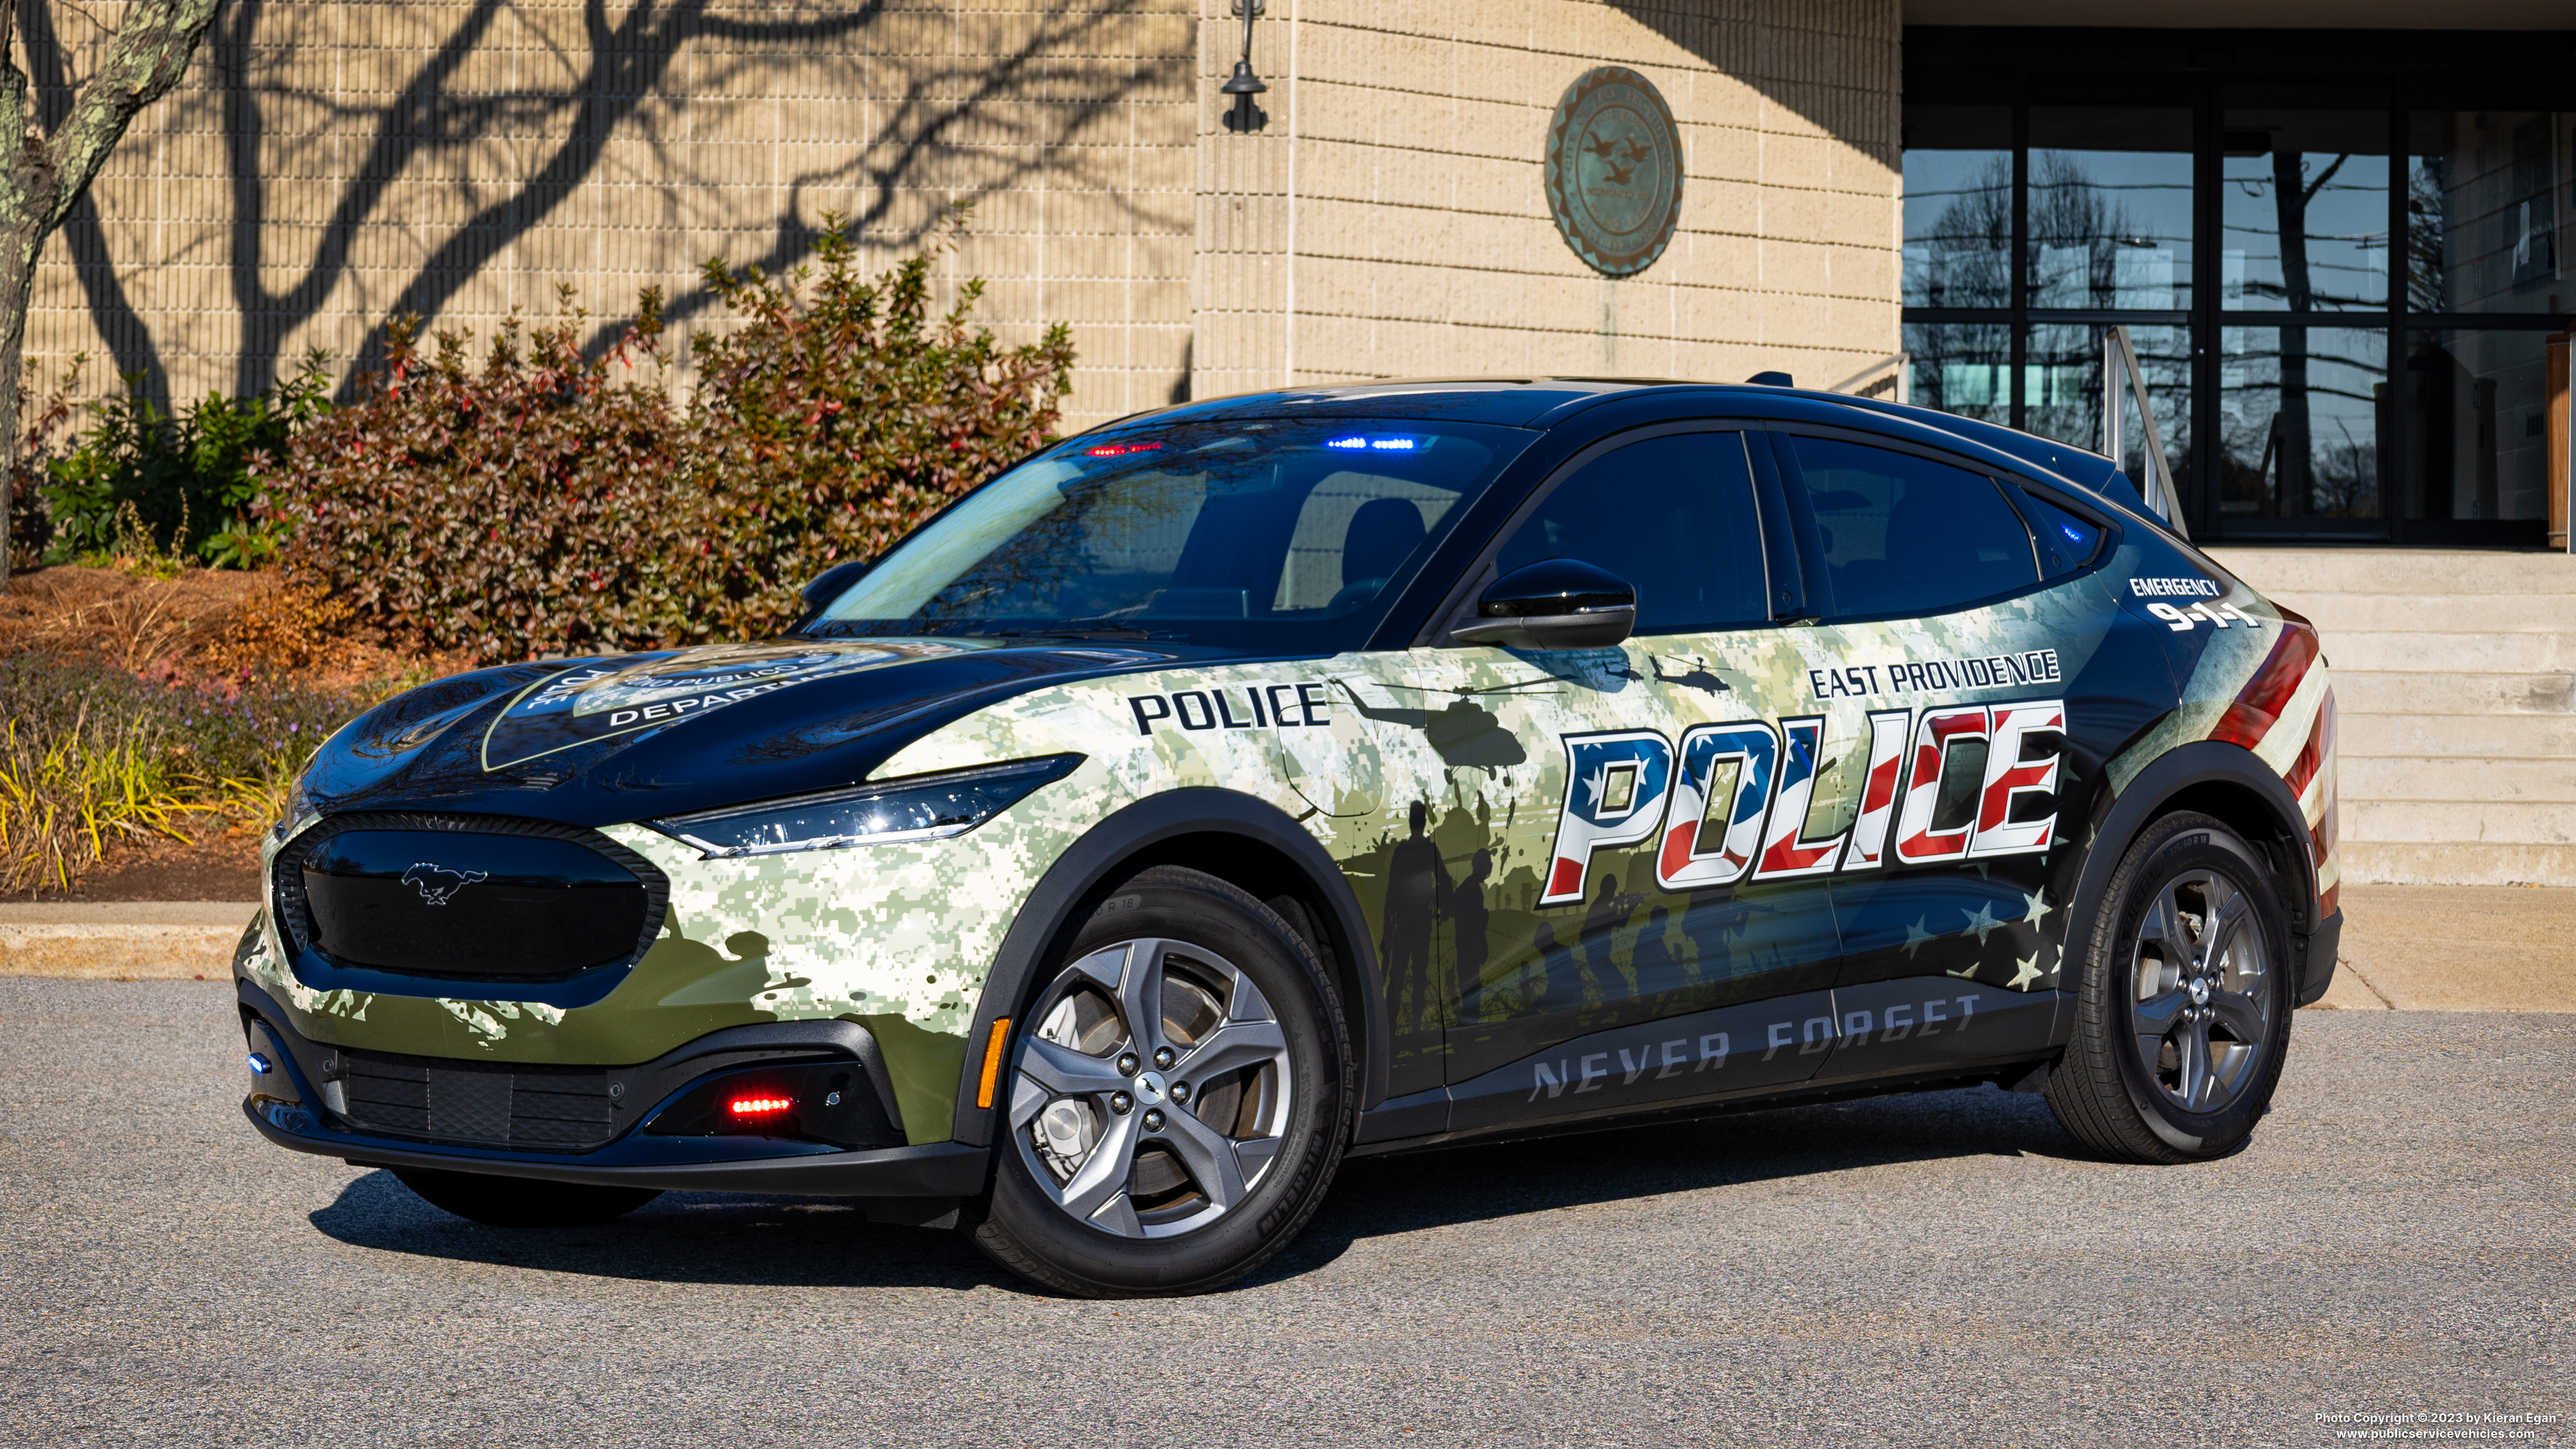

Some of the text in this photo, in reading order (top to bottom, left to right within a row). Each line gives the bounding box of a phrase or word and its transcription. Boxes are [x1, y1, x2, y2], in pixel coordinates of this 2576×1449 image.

[2129, 578, 2220, 597] EMERGENCY
[2147, 602, 2261, 632] 9-1-1
[674, 665, 798, 687] PUBLICO
[1808, 650, 2061, 699] EAST PROVIDENCE
[1127, 682, 1331, 737] POLICE
[1534, 699, 2066, 910] POLICE
[2194, 836, 2198, 844] R
[2200, 835, 2207, 843] 18
[1108, 901, 1116, 912] R
[1122, 898, 1134, 909] 18
[1527, 994, 1981, 1103] NEVER FORGET
[1260, 1133, 1325, 1233] MICHELIN
